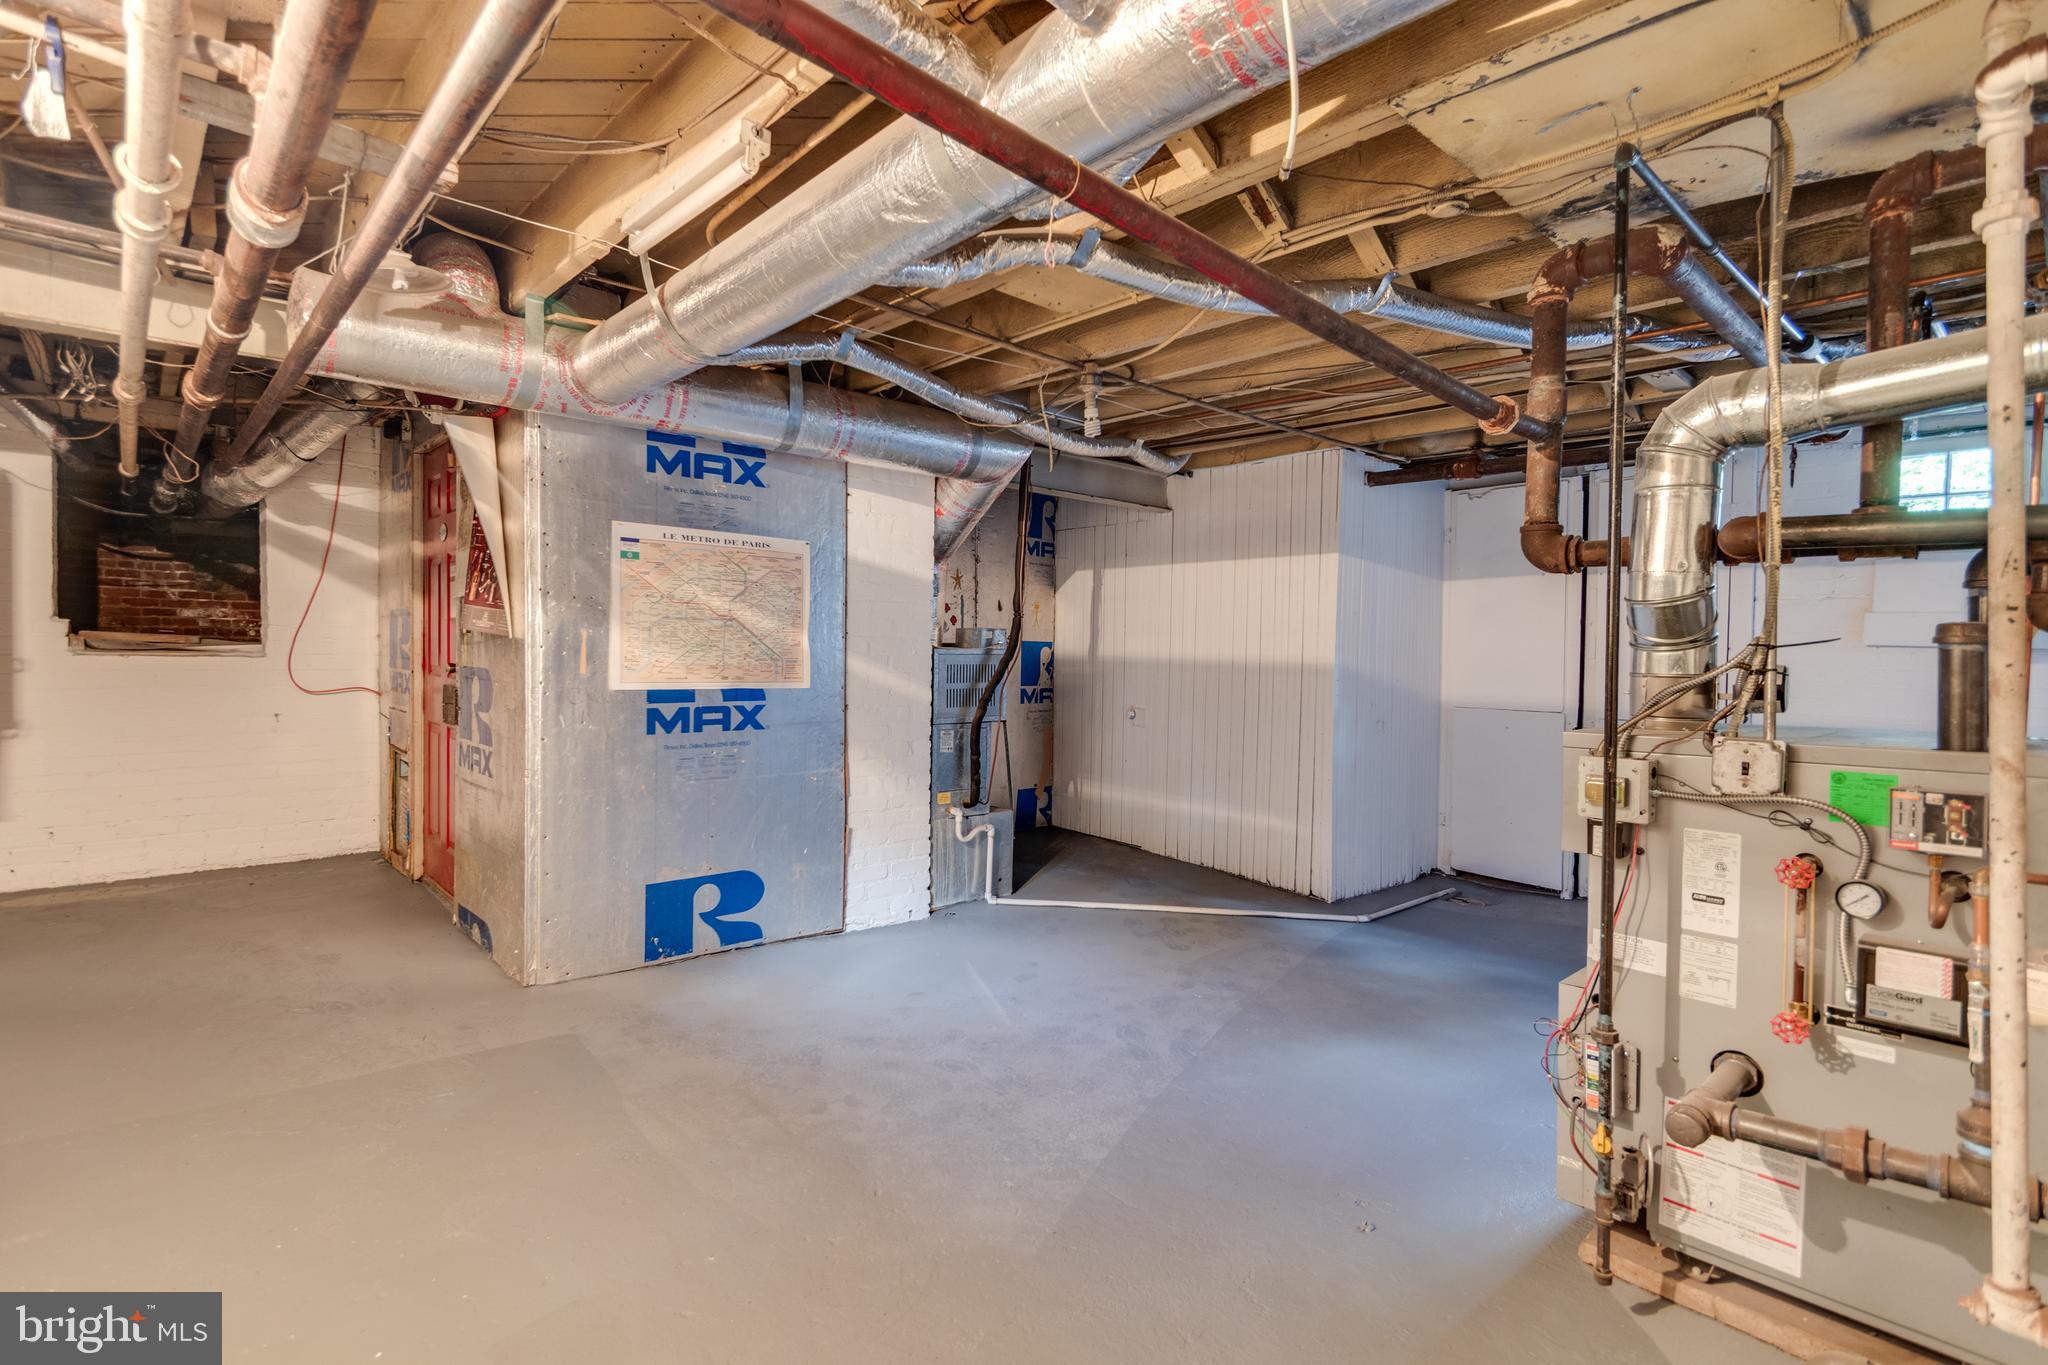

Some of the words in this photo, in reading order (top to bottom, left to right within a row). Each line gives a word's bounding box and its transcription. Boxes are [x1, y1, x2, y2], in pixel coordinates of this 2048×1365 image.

[646, 444, 766, 488] MAX
[662, 532, 676, 541] LE
[681, 534, 720, 545] METRO
[723, 538, 738, 546] DE
[741, 540, 771, 549] PARIS
[1027, 540, 1056, 558] MA
[458, 666, 494, 747] R
[1020, 687, 1055, 705] MA
[646, 704, 766, 736] MAX
[458, 741, 494, 779] MAX
[644, 869, 766, 963] R
